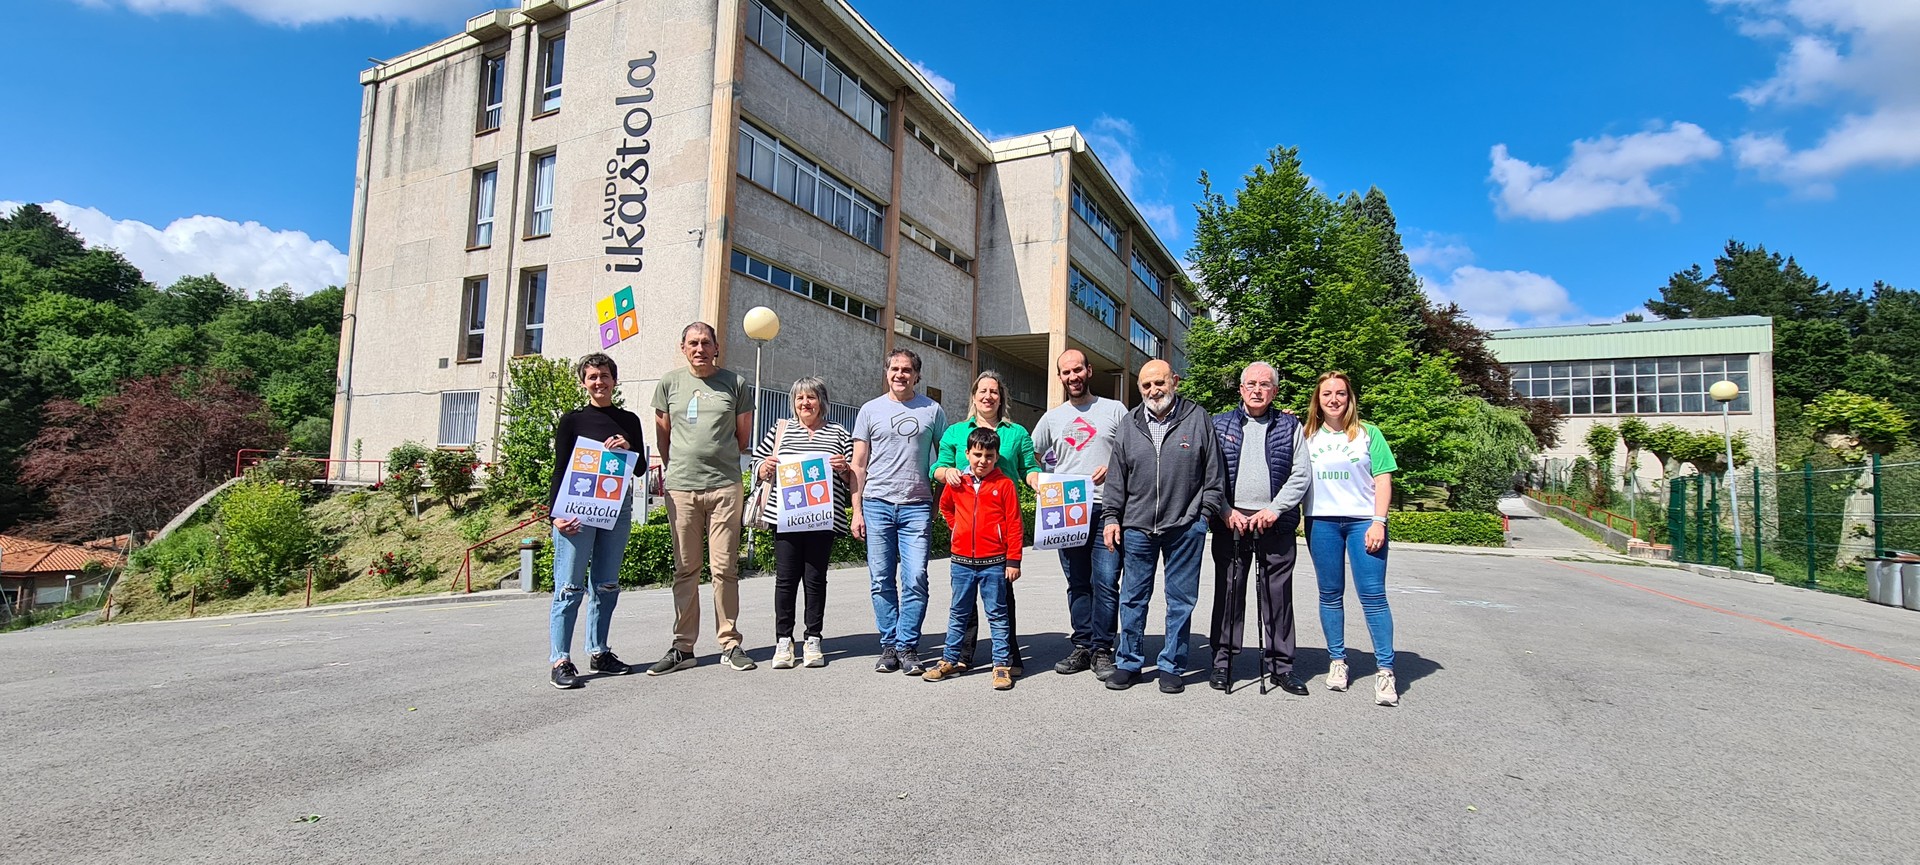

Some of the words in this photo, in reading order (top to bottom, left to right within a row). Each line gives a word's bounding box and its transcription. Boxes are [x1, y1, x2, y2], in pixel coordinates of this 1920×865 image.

[605, 50, 657, 272] ikastola
[602, 159, 618, 240] LAUDIO
[1318, 472, 1349, 480] LAUDIO
[565, 502, 618, 518] ikastola
[787, 510, 833, 527] ikastola
[1043, 531, 1087, 546] ikastola
